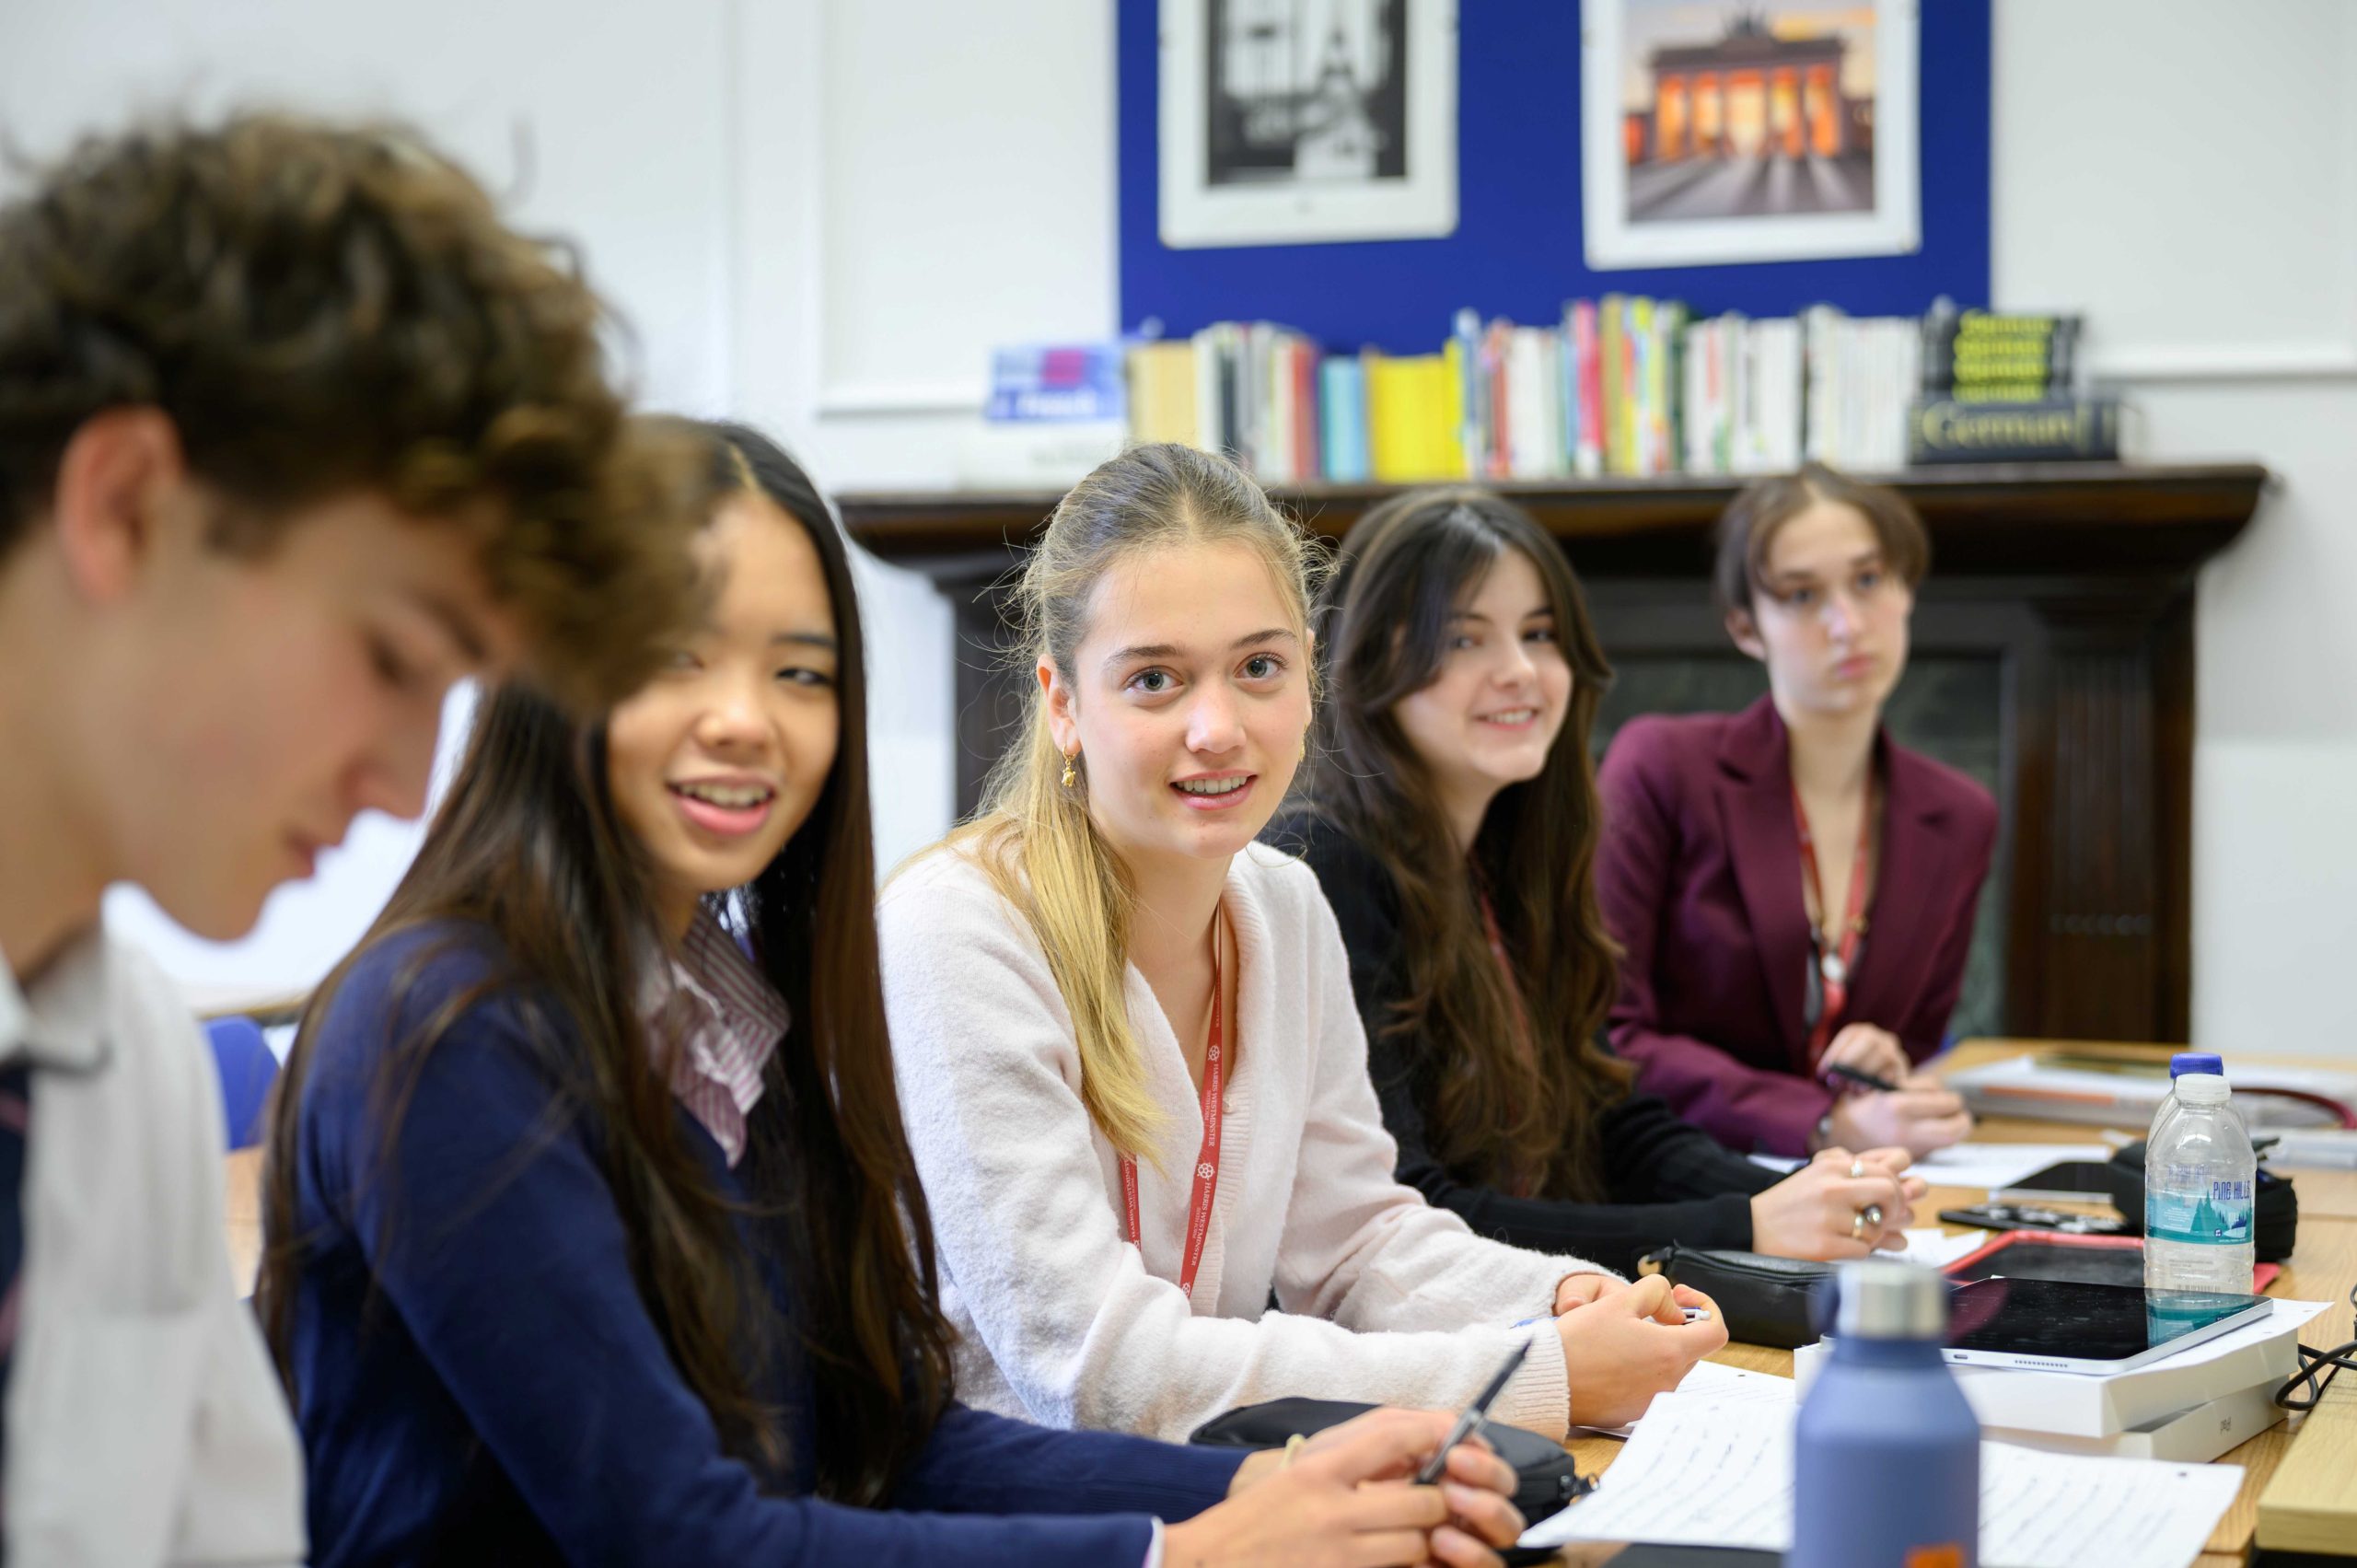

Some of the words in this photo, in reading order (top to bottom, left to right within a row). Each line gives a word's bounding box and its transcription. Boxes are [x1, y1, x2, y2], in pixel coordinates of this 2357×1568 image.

[1208, 1092, 1218, 1147] WESTMINSTER
[1202, 1181, 1212, 1211] HARRIS
[2212, 1181, 2231, 1200] PINE
[1191, 1211, 1207, 1267] WESTMINSTER
